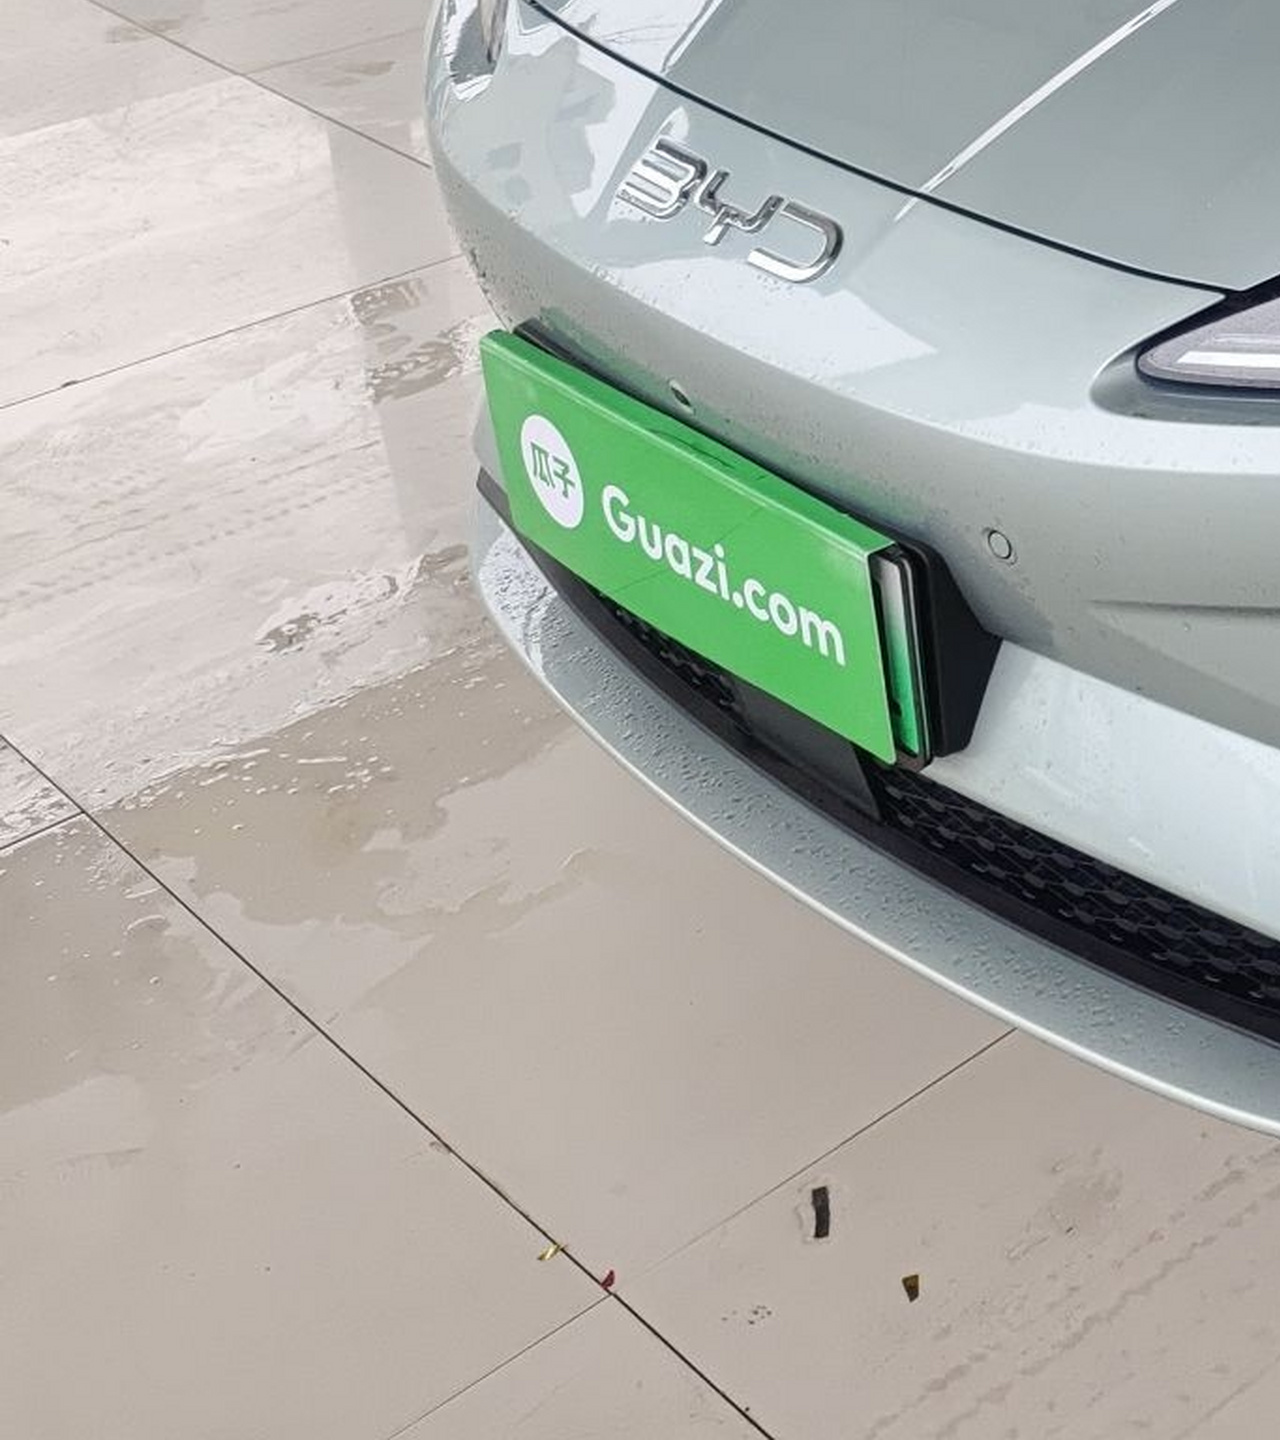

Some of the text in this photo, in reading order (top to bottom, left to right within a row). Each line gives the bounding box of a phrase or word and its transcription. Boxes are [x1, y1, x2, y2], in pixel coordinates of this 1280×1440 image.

[615, 137, 844, 284] BYD
[530, 440, 576, 499] 瓜子
[602, 485, 845, 666] Guazi.com
